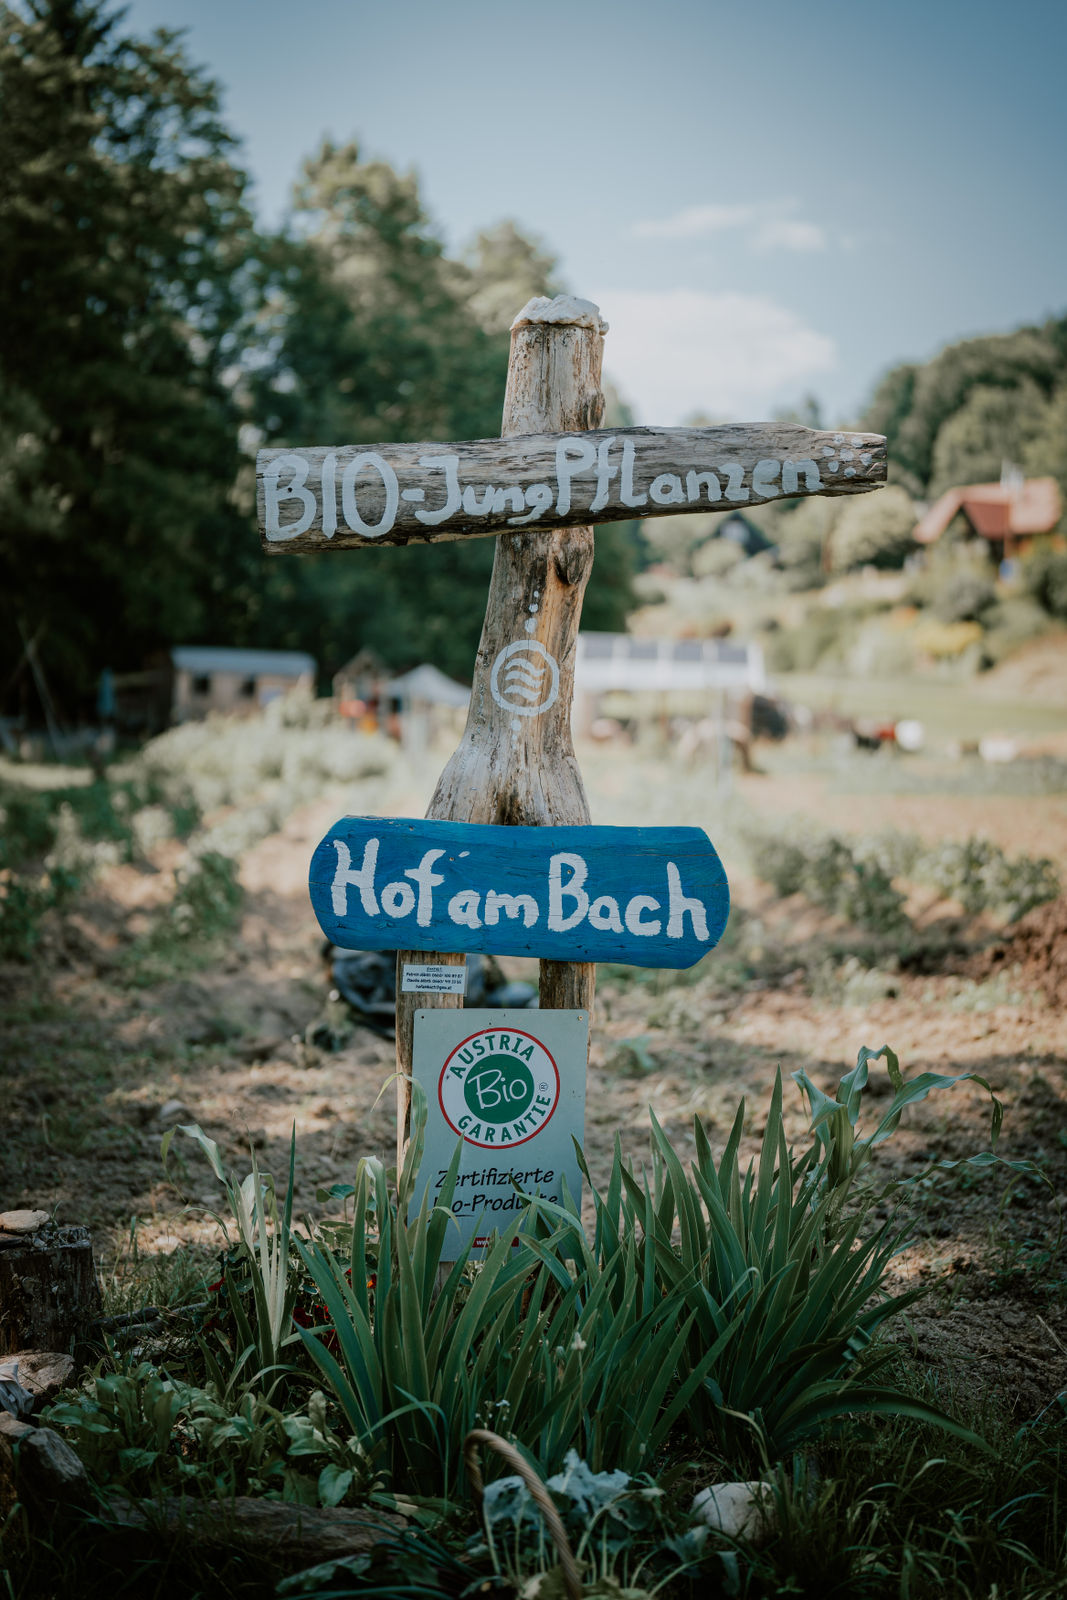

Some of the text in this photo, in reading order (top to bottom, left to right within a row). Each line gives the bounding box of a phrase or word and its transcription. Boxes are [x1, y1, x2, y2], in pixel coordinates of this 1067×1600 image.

[331, 837, 710, 942] Hof am Bach
[449, 1034, 535, 1079] AUSTRIA
[467, 1069, 527, 1110] Bio
[458, 1094, 551, 1142] GARANTIE
[432, 1191, 558, 1214] o-Produe
